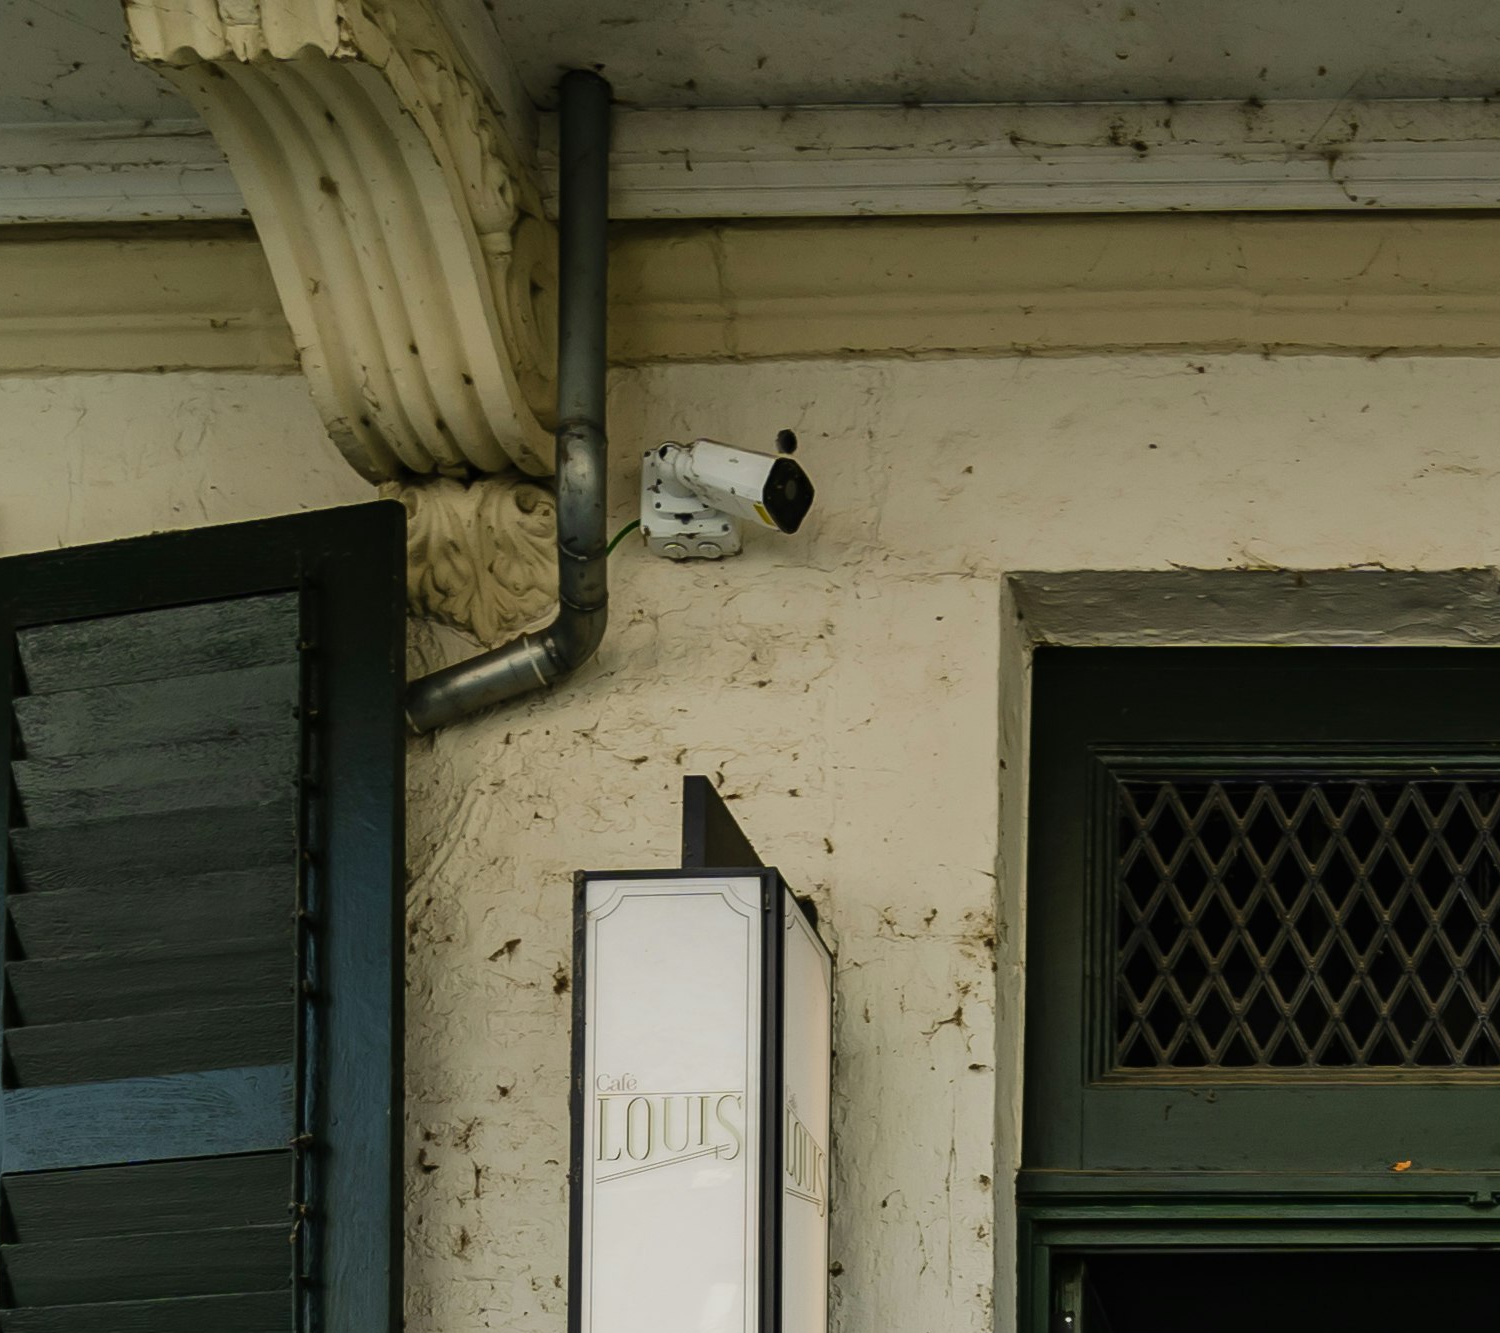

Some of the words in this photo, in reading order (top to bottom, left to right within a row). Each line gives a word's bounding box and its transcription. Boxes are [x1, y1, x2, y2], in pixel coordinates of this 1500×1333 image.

[596, 1073, 637, 1092] Café
[596, 1095, 742, 1162] LOUIS
[786, 1109, 826, 1218] LOUIS
